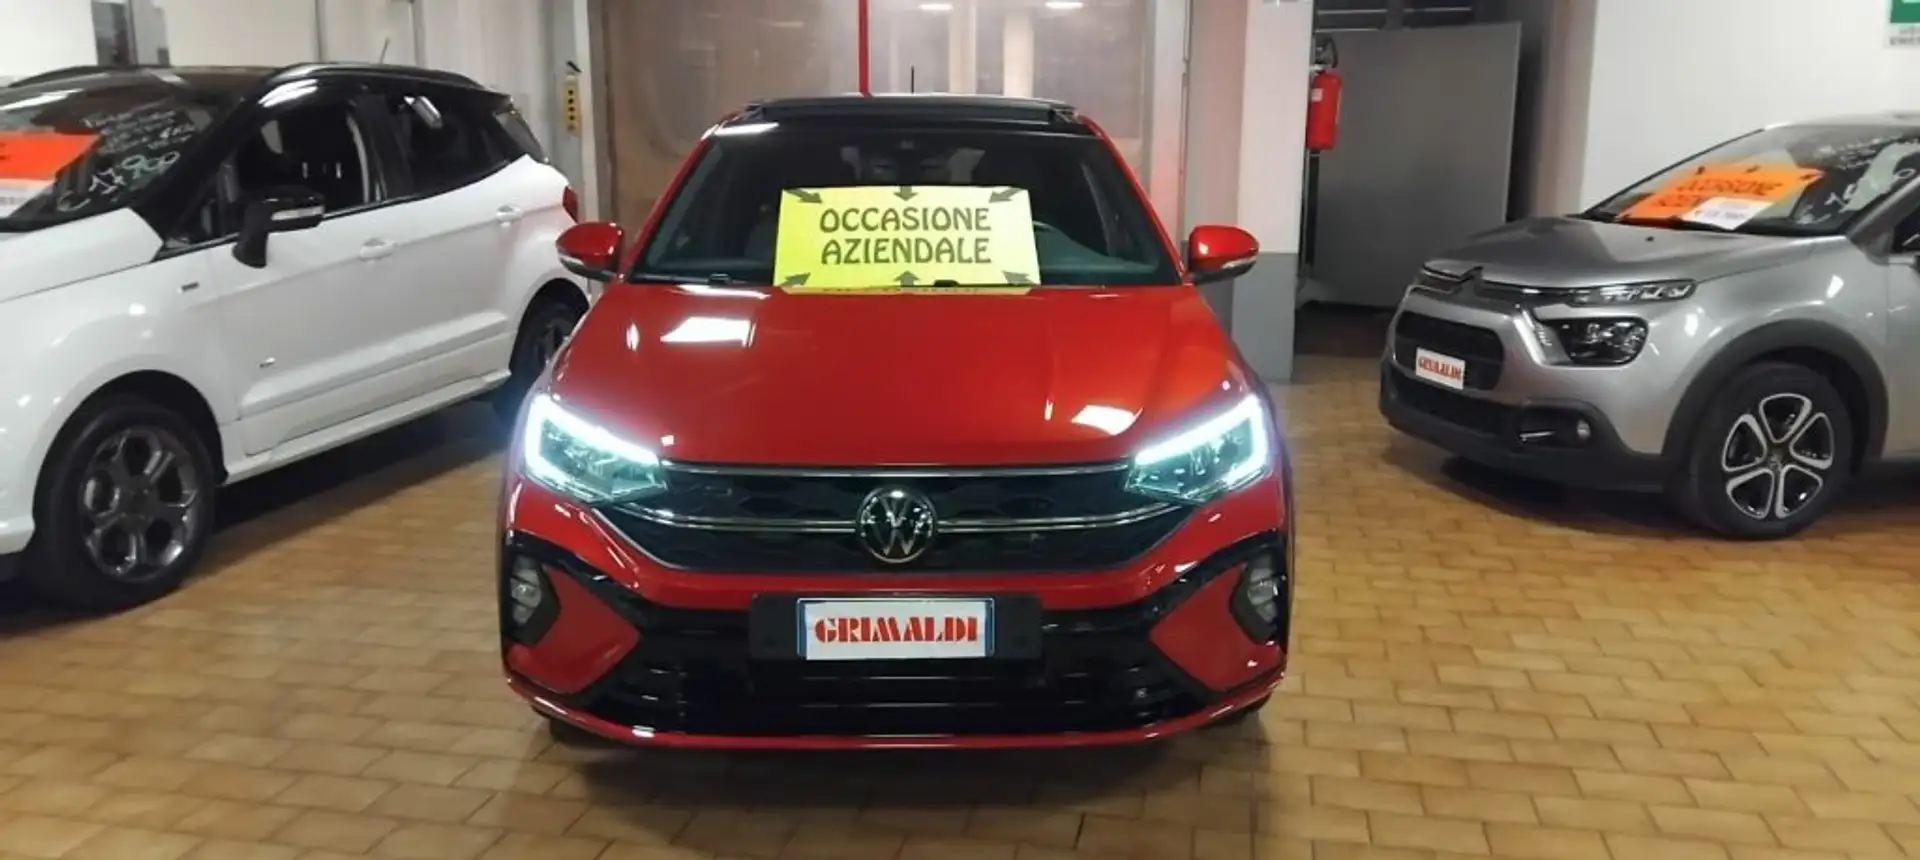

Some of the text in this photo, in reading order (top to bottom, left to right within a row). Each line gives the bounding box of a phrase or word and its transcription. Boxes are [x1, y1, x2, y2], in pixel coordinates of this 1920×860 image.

[819, 206, 992, 234] OCCASIONE
[820, 236, 992, 265] AZIENDALE
[814, 615, 978, 644] GRIMALDI
